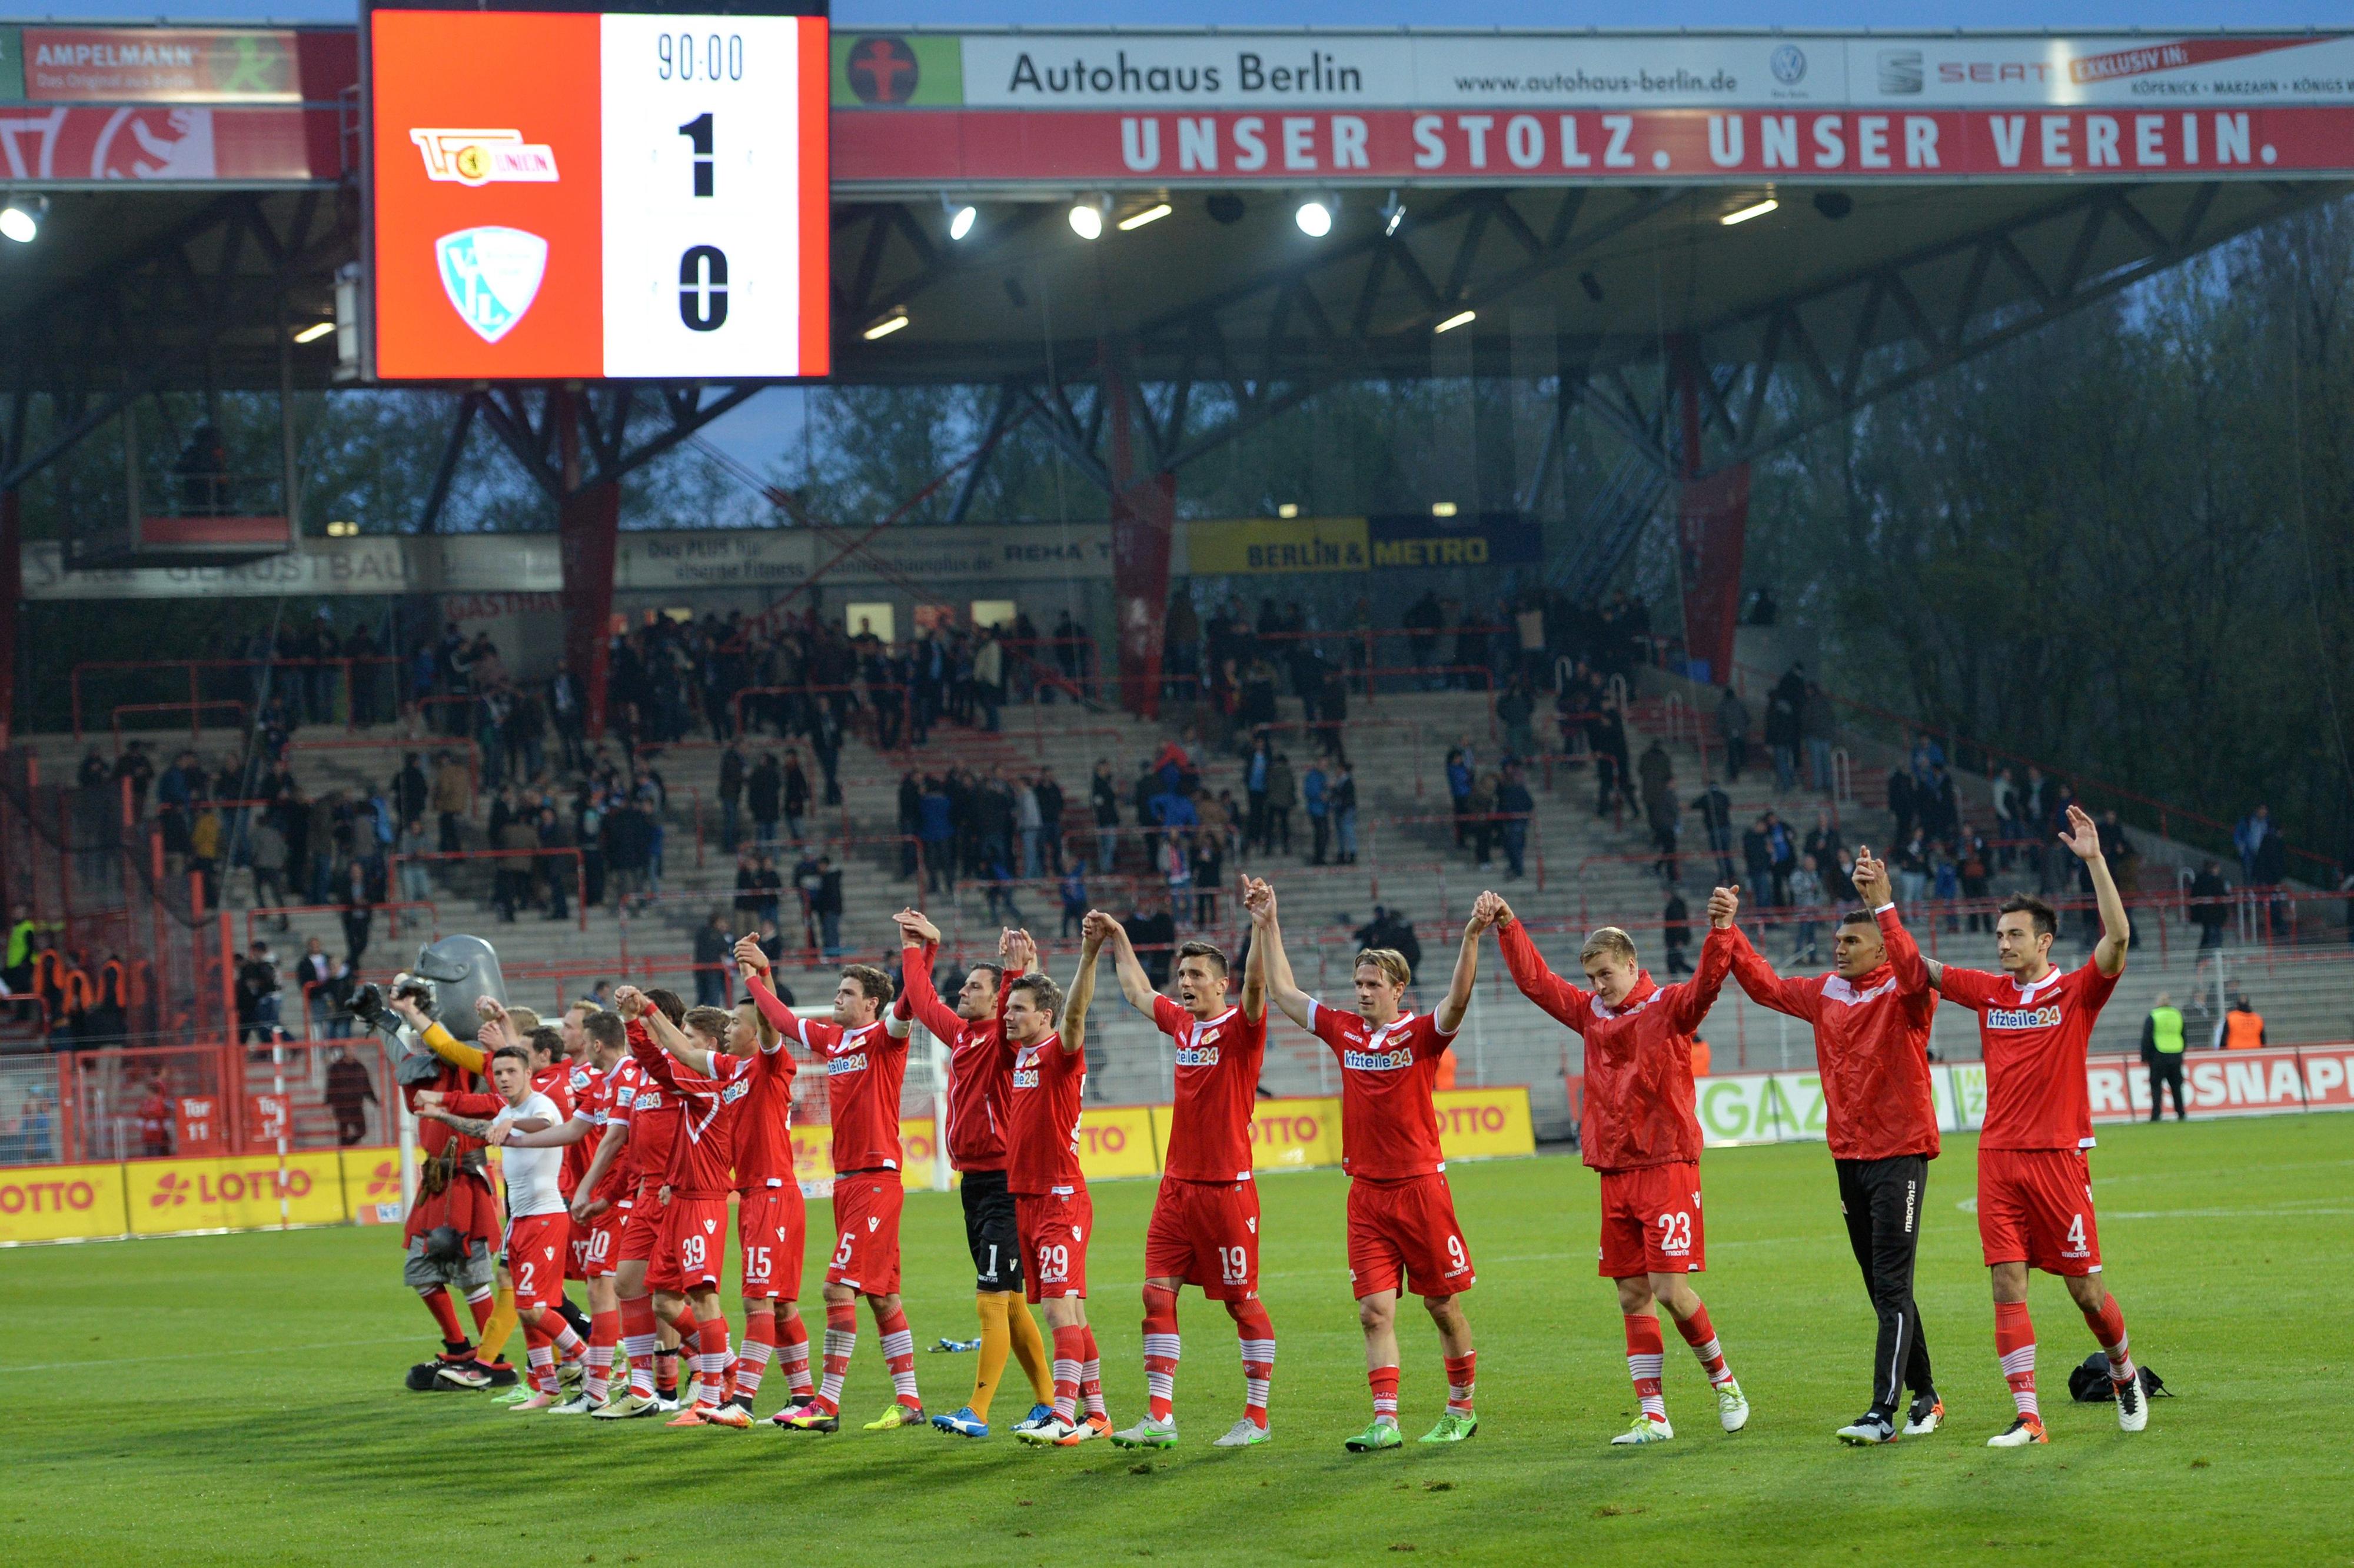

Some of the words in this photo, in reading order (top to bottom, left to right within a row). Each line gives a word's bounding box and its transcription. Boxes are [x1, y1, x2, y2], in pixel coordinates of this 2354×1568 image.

[36, 44, 192, 66] AMPELMANN
[659, 34, 742, 81] 90:00
[1008, 51, 1221, 93] Autohaus
[1238, 51, 1362, 92] Berlin
[1455, 68, 1737, 94] www.autohaus-berlin.de
[1938, 62, 2054, 84] SEAT
[679, 113, 714, 197] 1
[1120, 116, 1371, 171] UNSER
[1413, 115, 1672, 169] STOLZ.
[1708, 114, 1941, 168] UNSER
[1989, 113, 2277, 168] VEREIN.
[679, 245, 729, 332] 0
[1374, 537, 1489, 566] METRO
[1989, 1008, 2059, 1026] kfzteile24
[1345, 1050, 1411, 1068] kfzteile24
[182, 1098, 212, 1117] Tor
[255, 1097, 279, 1115] To
[188, 1122, 209, 1141] 11
[200, 1169, 312, 1204] LOTTO
[1907, 1180, 1916, 1190] 21
[1905, 1190, 1916, 1233] macron
[589, 1228, 611, 1259] 10
[1658, 1211, 1691, 1250] 23
[2067, 1214, 2087, 1251] 4
[683, 1235, 705, 1267] 39
[746, 1247, 772, 1277] 15
[836, 1232, 856, 1264] 5
[986, 1244, 998, 1277] 1
[1040, 1244, 1068, 1279] 29
[1218, 1246, 1247, 1280] 19
[1448, 1235, 1465, 1268] 9
[520, 1262, 534, 1291] 2
[1445, 1266, 1469, 1279] macron
